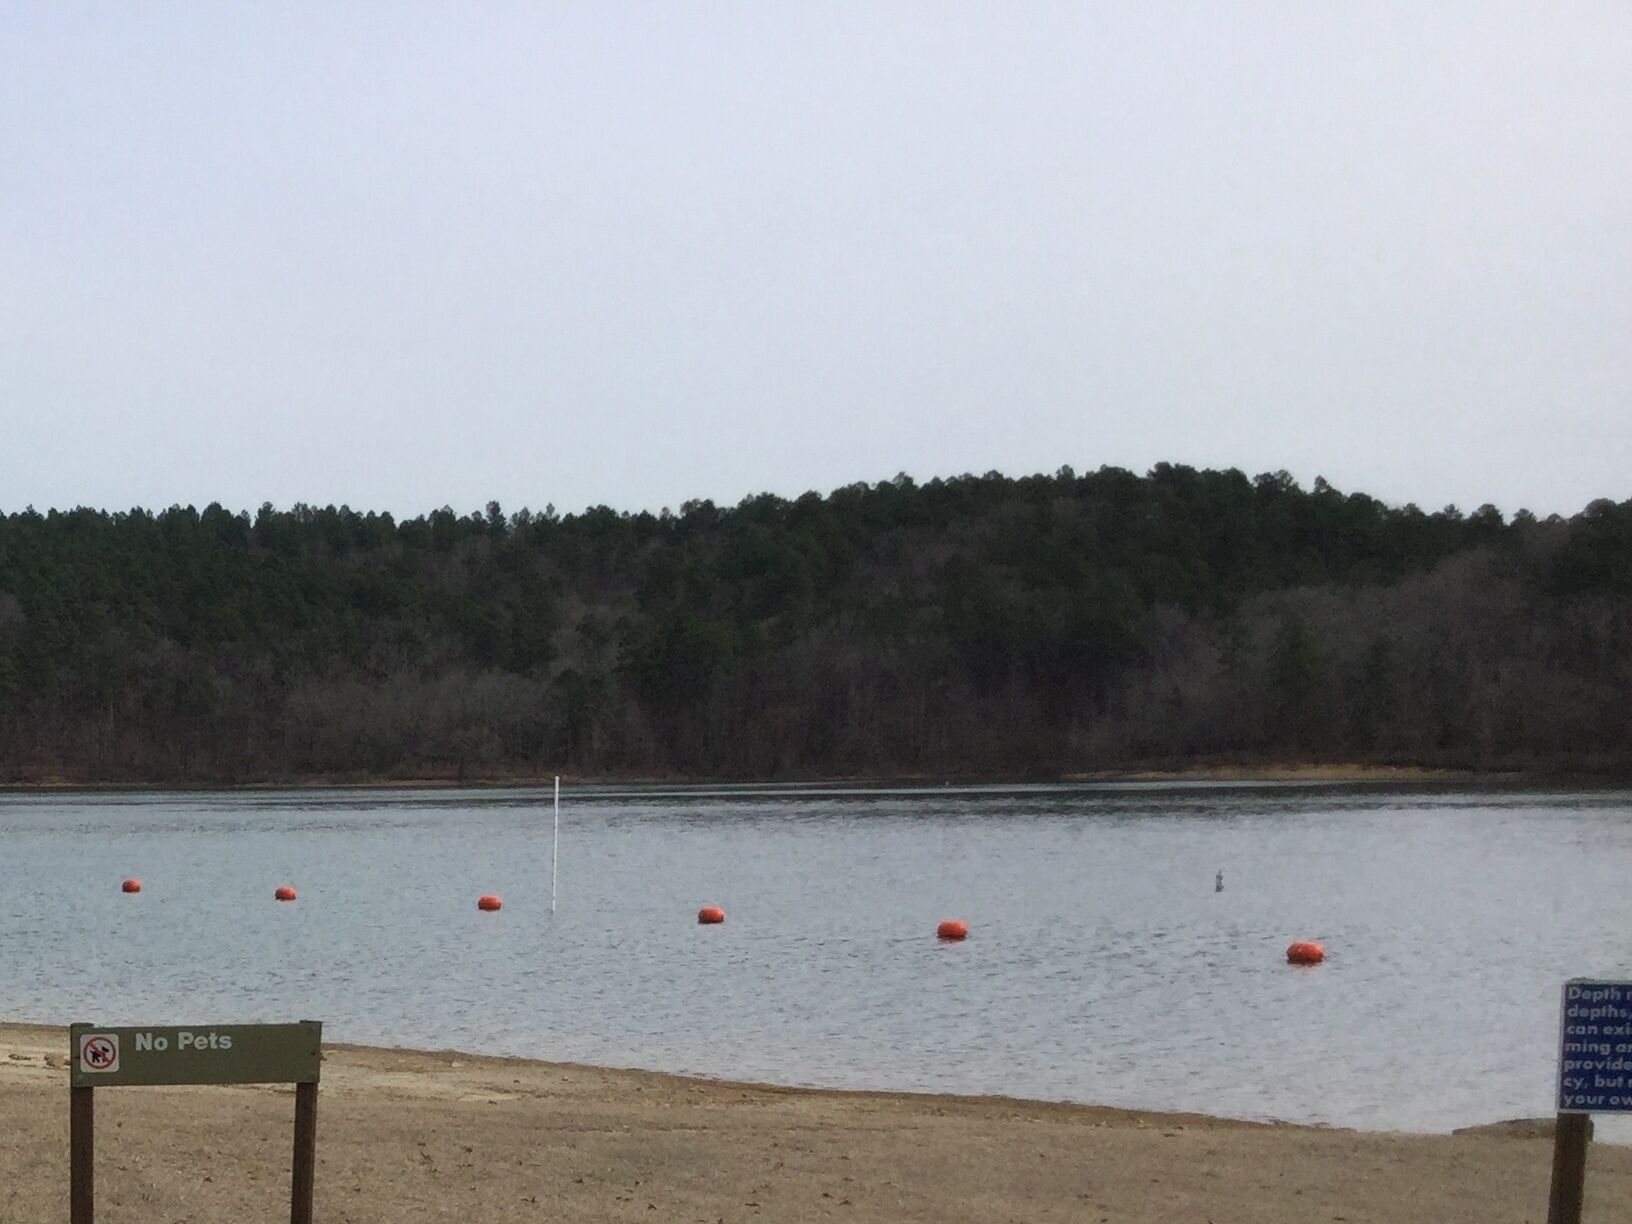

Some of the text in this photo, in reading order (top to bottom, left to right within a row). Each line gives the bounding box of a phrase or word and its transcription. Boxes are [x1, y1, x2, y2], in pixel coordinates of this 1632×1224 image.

[1568, 987, 1621, 1002] Depth
[1567, 1022, 1632, 1035] can exi
[135, 1031, 232, 1051] No Pets
[1564, 1039, 1611, 1055] ming
[1594, 1073, 1624, 1087] but
[1564, 1094, 1605, 1107] your
